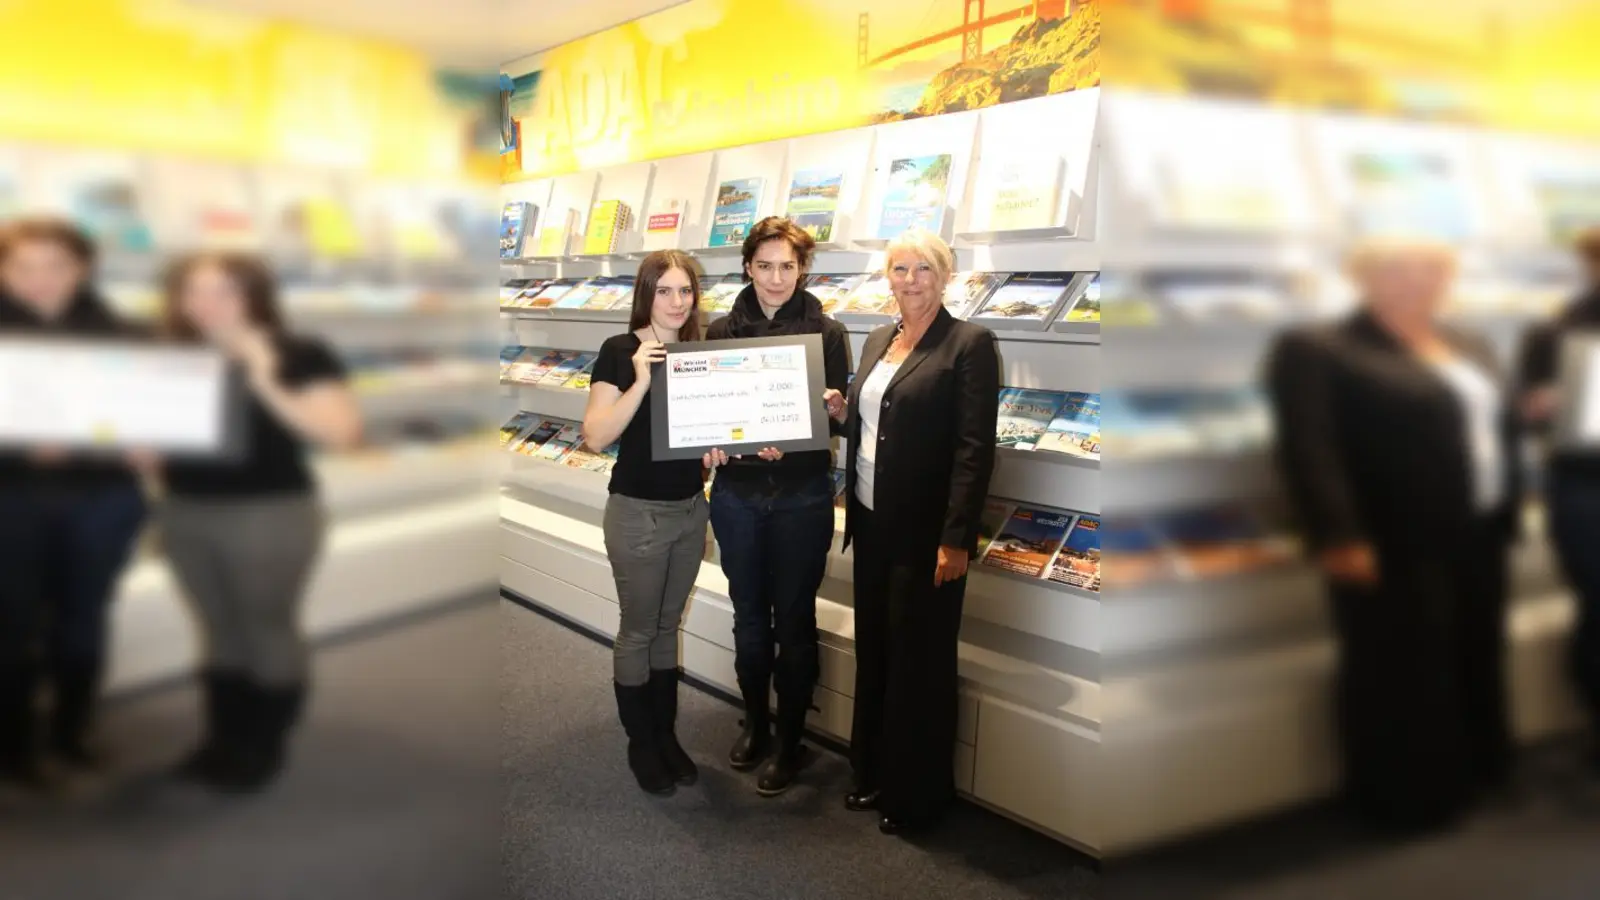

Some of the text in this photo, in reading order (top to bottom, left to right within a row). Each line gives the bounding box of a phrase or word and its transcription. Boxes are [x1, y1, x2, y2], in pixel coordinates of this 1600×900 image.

[536, 38, 690, 153] ADAC
[1003, 402, 1052, 415] New York
